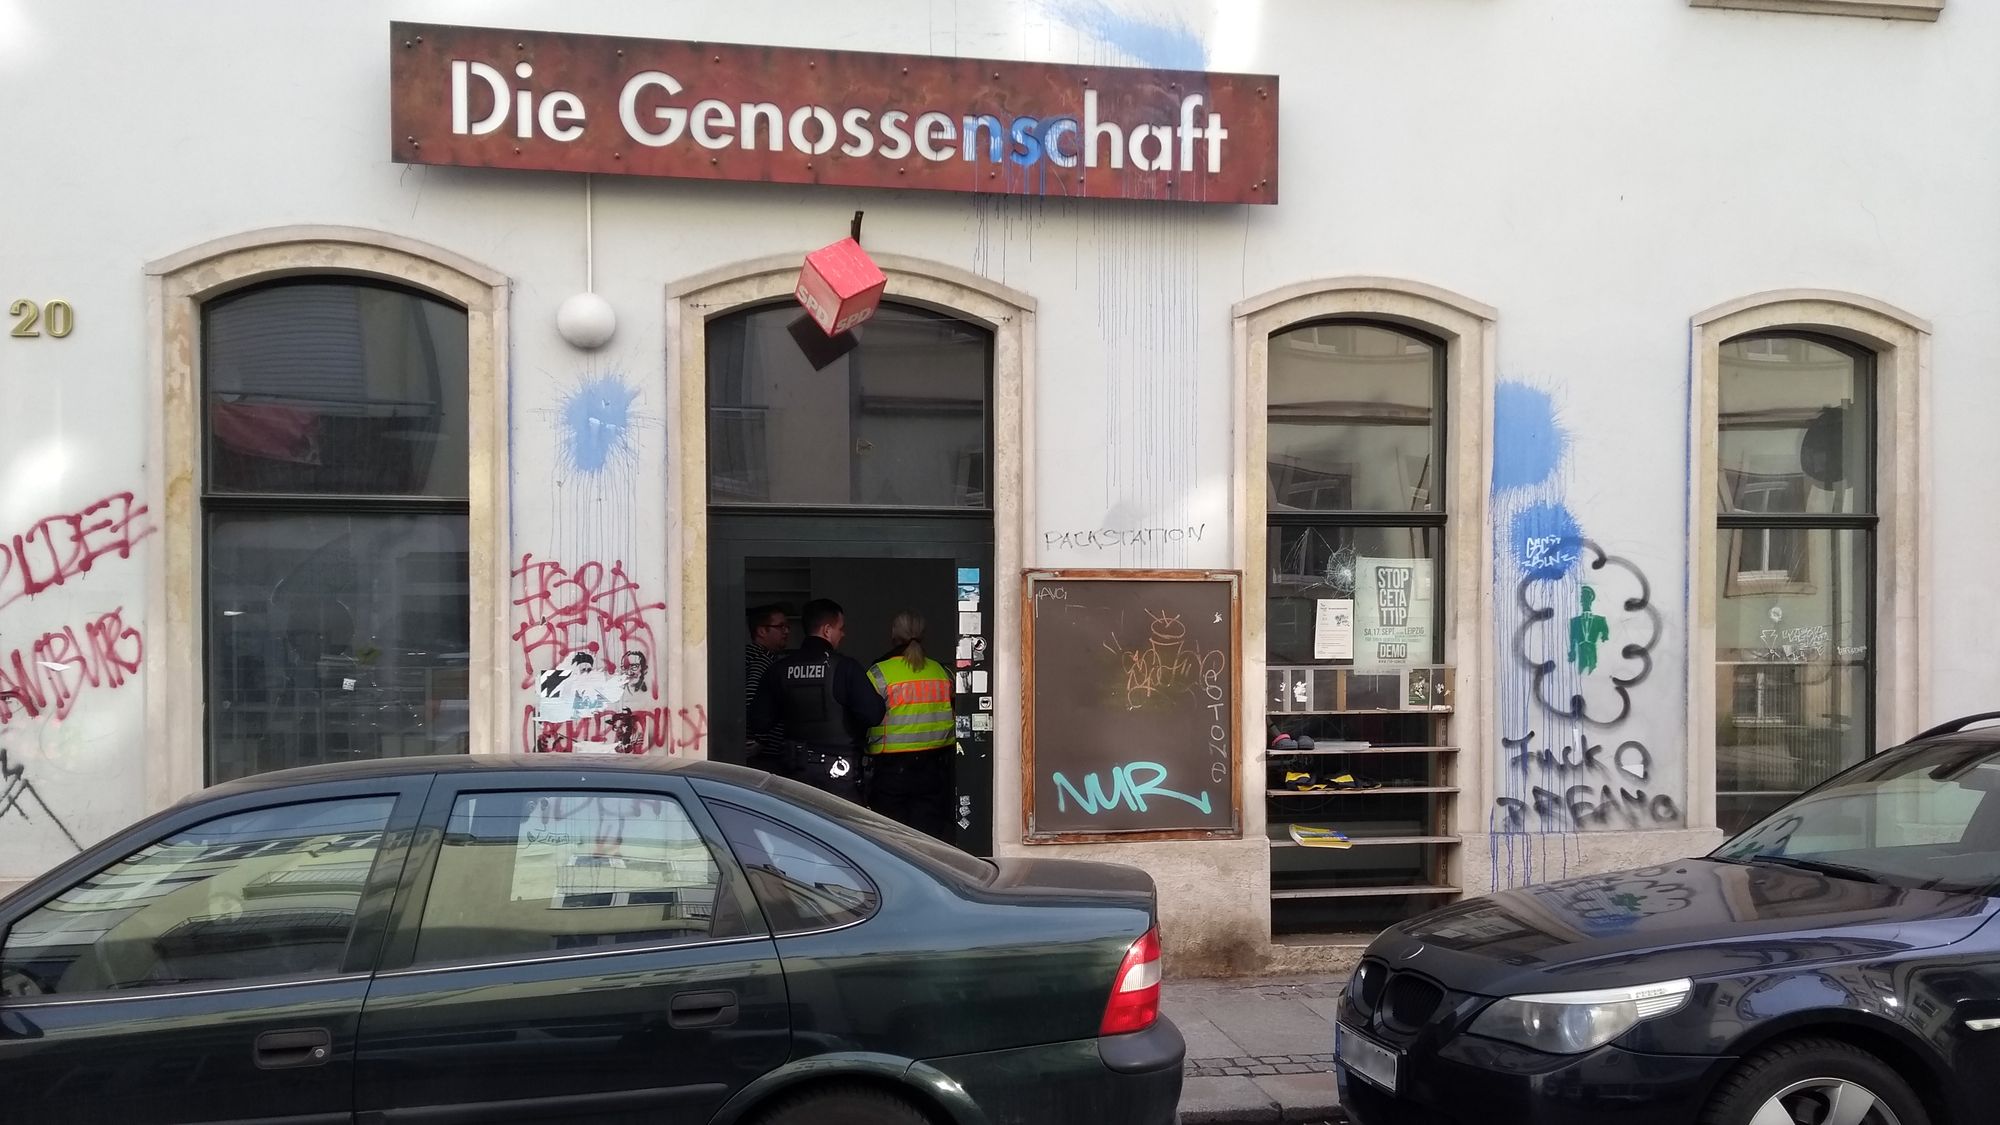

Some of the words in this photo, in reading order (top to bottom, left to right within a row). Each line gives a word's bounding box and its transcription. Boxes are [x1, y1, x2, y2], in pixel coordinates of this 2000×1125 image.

[452, 60, 586, 142] Die
[618, 71, 1228, 174] Genossenschaft
[797, 284, 829, 324] SPD
[9, 298, 74, 338] 20
[835, 307, 872, 331] SPD
[1045, 524, 1206, 551] PACKSTATION
[1377, 568, 1409, 588] STOP
[1379, 589, 1408, 607] CETA
[1381, 608, 1407, 625] TTIP
[1404, 626, 1425, 635] LEIPZIG
[1380, 643, 1406, 658] DEMO
[787, 665, 826, 679] POLIZEI
[892, 681, 951, 704] POLIZEI
[1053, 761, 1212, 815] NUR
